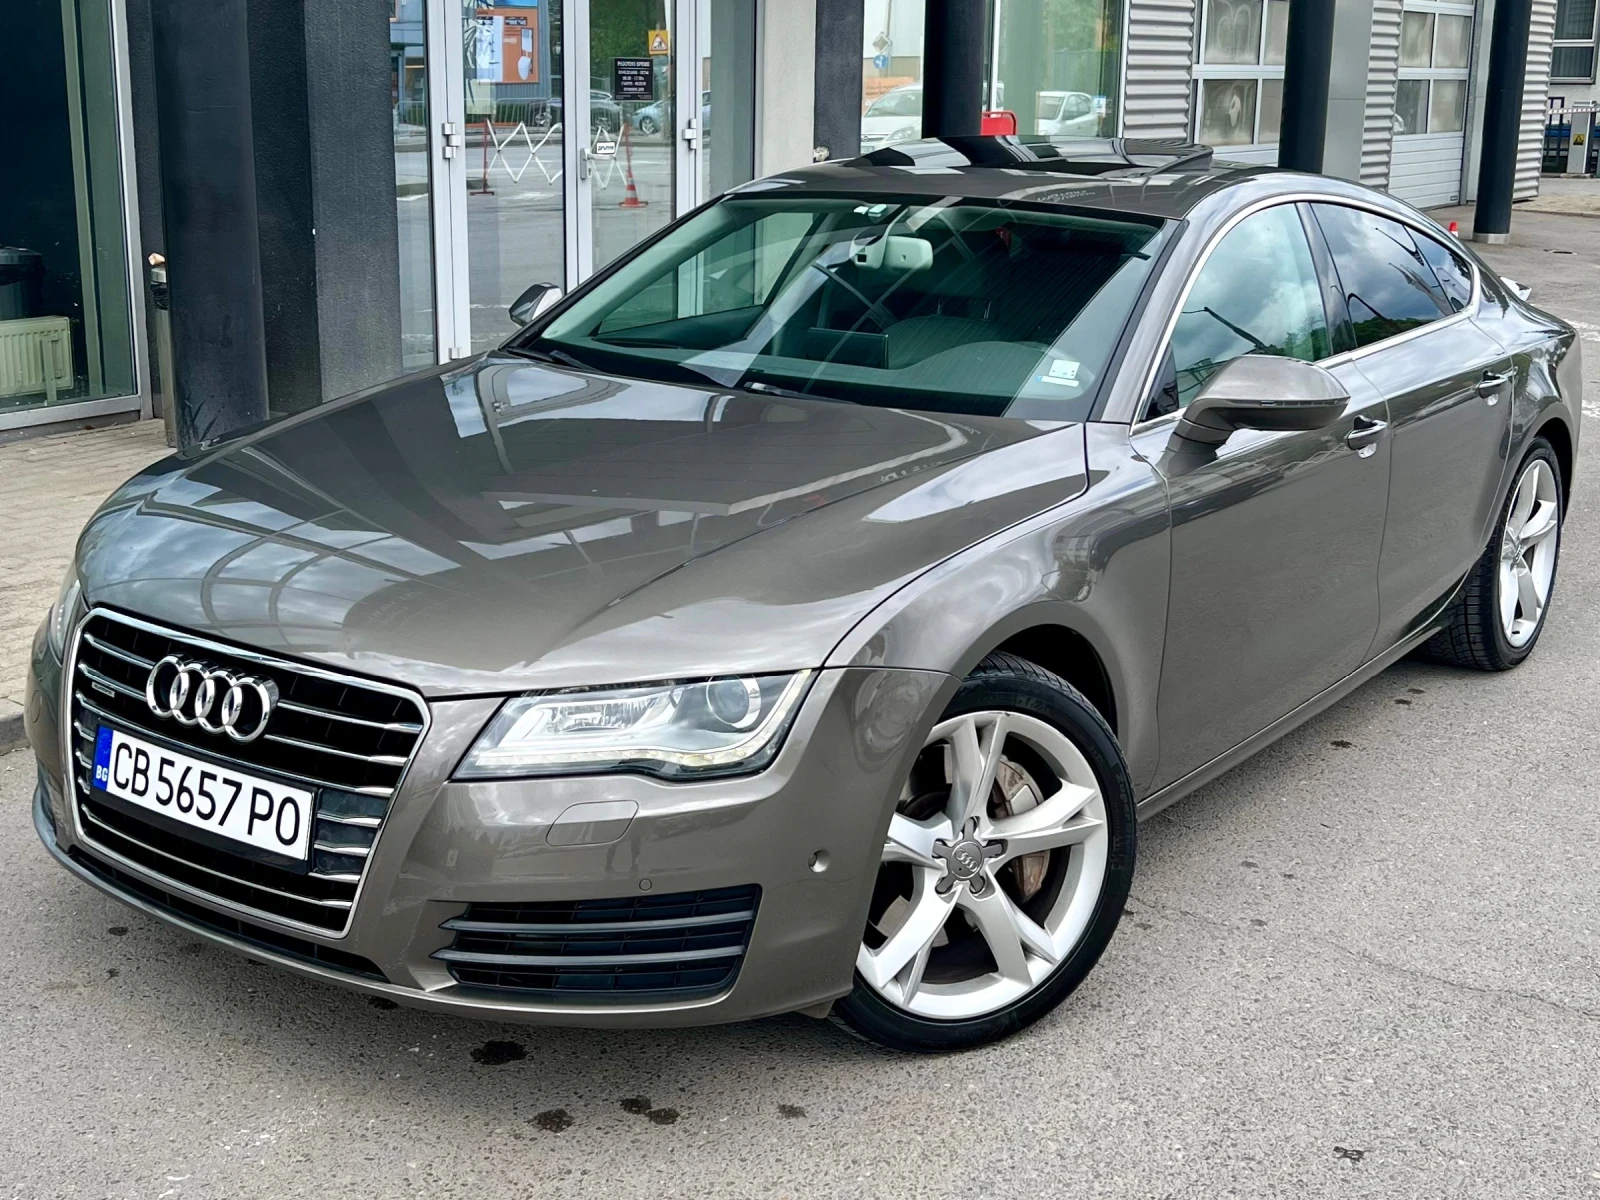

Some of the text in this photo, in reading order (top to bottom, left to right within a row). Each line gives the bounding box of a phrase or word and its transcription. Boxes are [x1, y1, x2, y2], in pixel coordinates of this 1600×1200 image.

[95, 765, 108, 782] BG
[113, 742, 300, 846] CB 5657 PO
